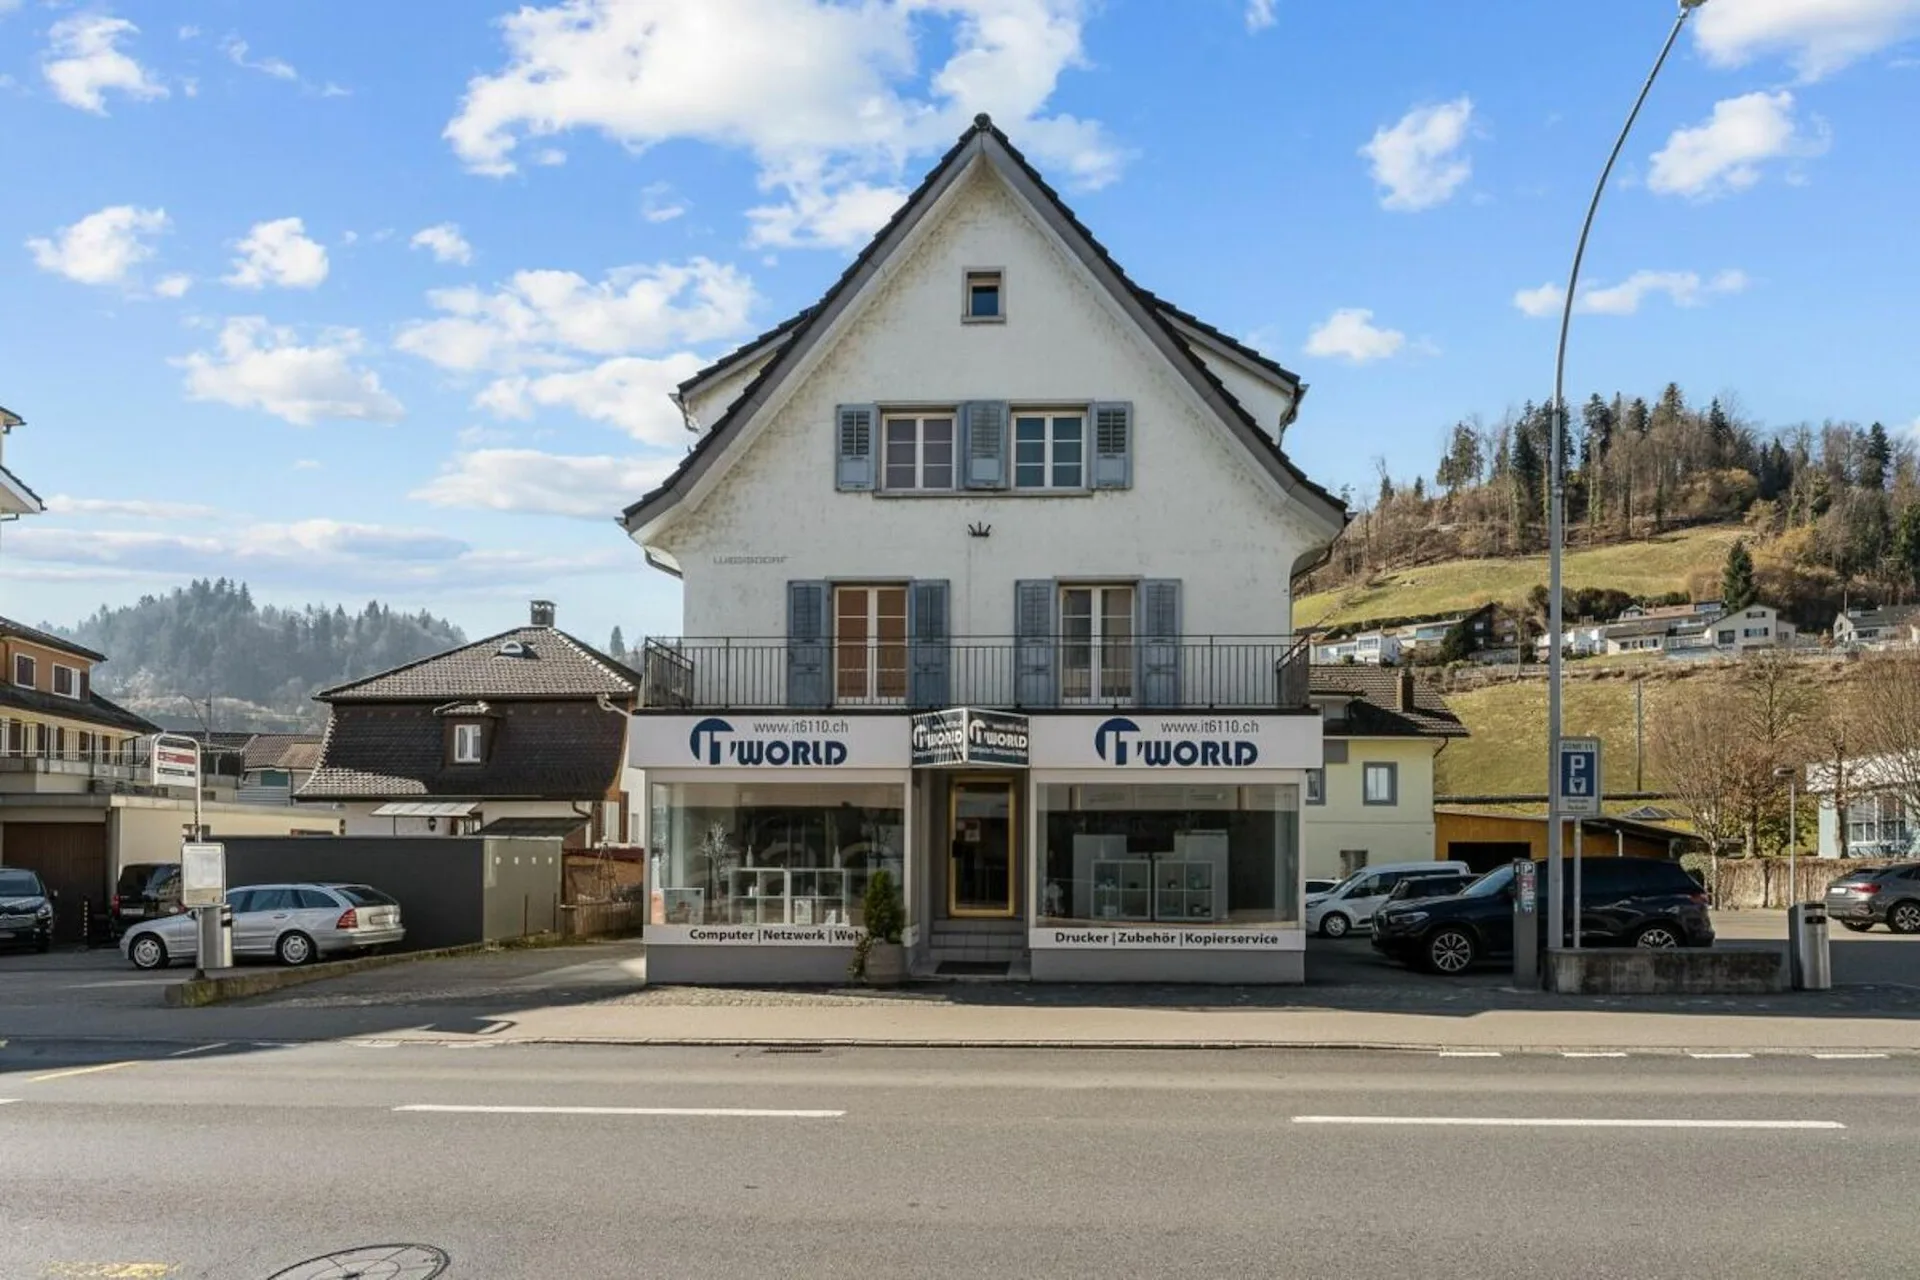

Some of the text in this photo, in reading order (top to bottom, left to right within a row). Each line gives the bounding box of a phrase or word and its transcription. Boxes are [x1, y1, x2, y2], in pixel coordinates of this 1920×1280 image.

[753, 719, 849, 734] www.it6110.ch
[1161, 719, 1259, 734] www.it6110.ch
[1570, 755, 1586, 777] P
[689, 929, 754, 941] Computer
[763, 929, 825, 941] Netzwerk
[1055, 932, 1278, 946] Drucker Zubehör Kopierservice
